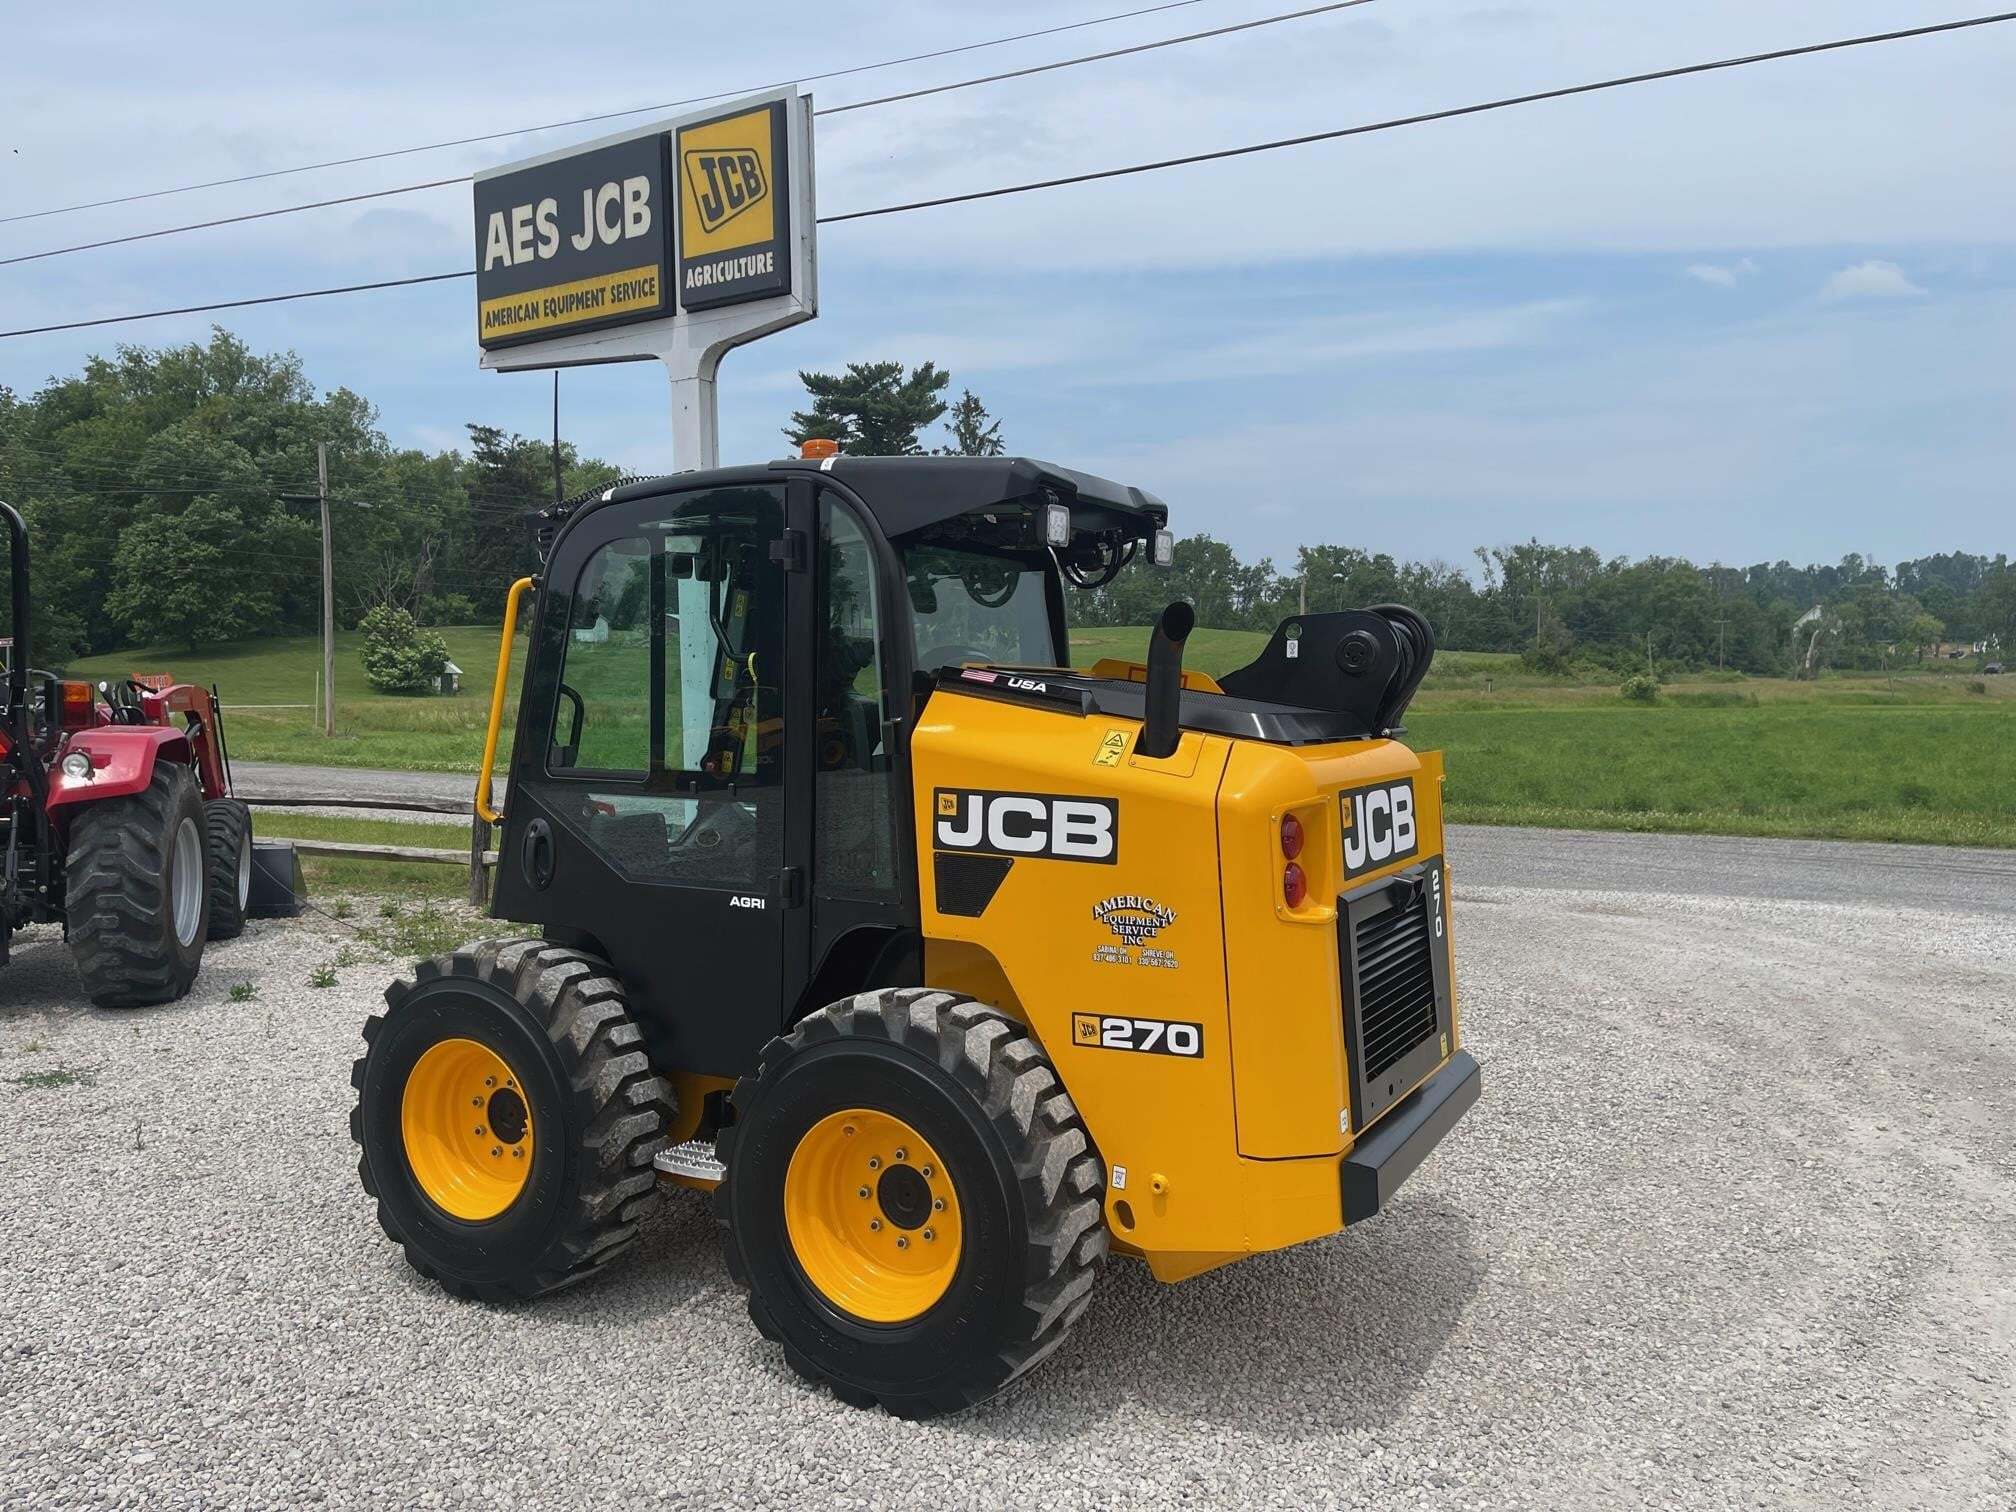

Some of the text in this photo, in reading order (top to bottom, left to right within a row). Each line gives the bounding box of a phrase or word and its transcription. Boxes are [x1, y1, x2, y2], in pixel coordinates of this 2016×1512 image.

[699, 155, 761, 222] JCB
[484, 175, 651, 272] AES JCB
[686, 251, 774, 289] AGRICULTURE
[484, 276, 656, 329] AMERICAN EQUIPMENT SERVICE
[1007, 677, 1047, 693] USA
[937, 794, 1113, 858] JCB
[1342, 784, 1416, 870] JCB
[729, 895, 766, 910] AGRI
[1093, 895, 1177, 924] AMERICAN
[1102, 914, 1168, 928] EQUIPMENT
[1432, 869, 1443, 938] 270
[1112, 924, 1157, 937] SERVICE
[1102, 1018, 1199, 1055] 270
